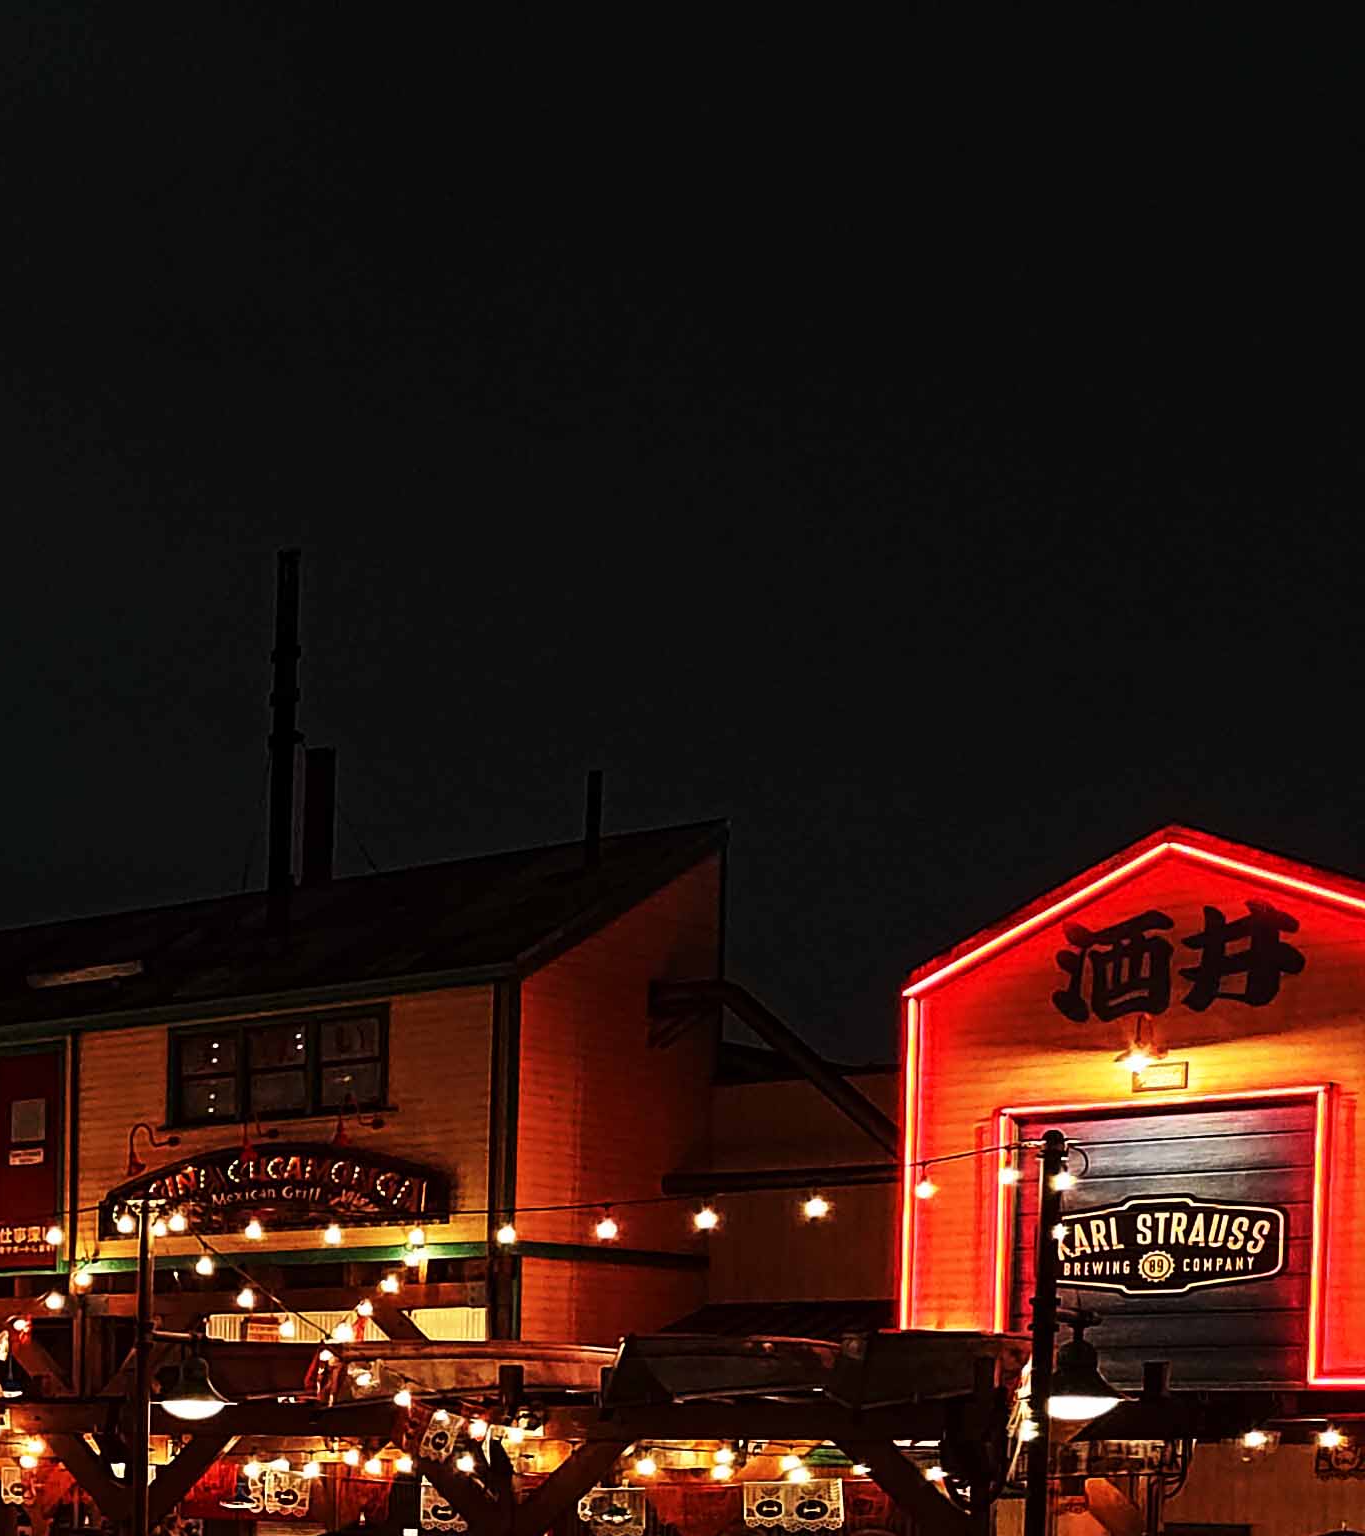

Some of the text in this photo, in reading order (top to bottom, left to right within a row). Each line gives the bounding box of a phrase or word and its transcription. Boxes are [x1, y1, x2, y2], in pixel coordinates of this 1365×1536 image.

[1052, 900, 1306, 1023] 酒井
[212, 1187, 277, 1209] Mexican
[281, 1185, 322, 1203] Grill
[1135, 1211, 1272, 1254] STRAUSS
[1063, 1261, 1131, 1277] BREWING
[1182, 1256, 1255, 1273] COMPANY
